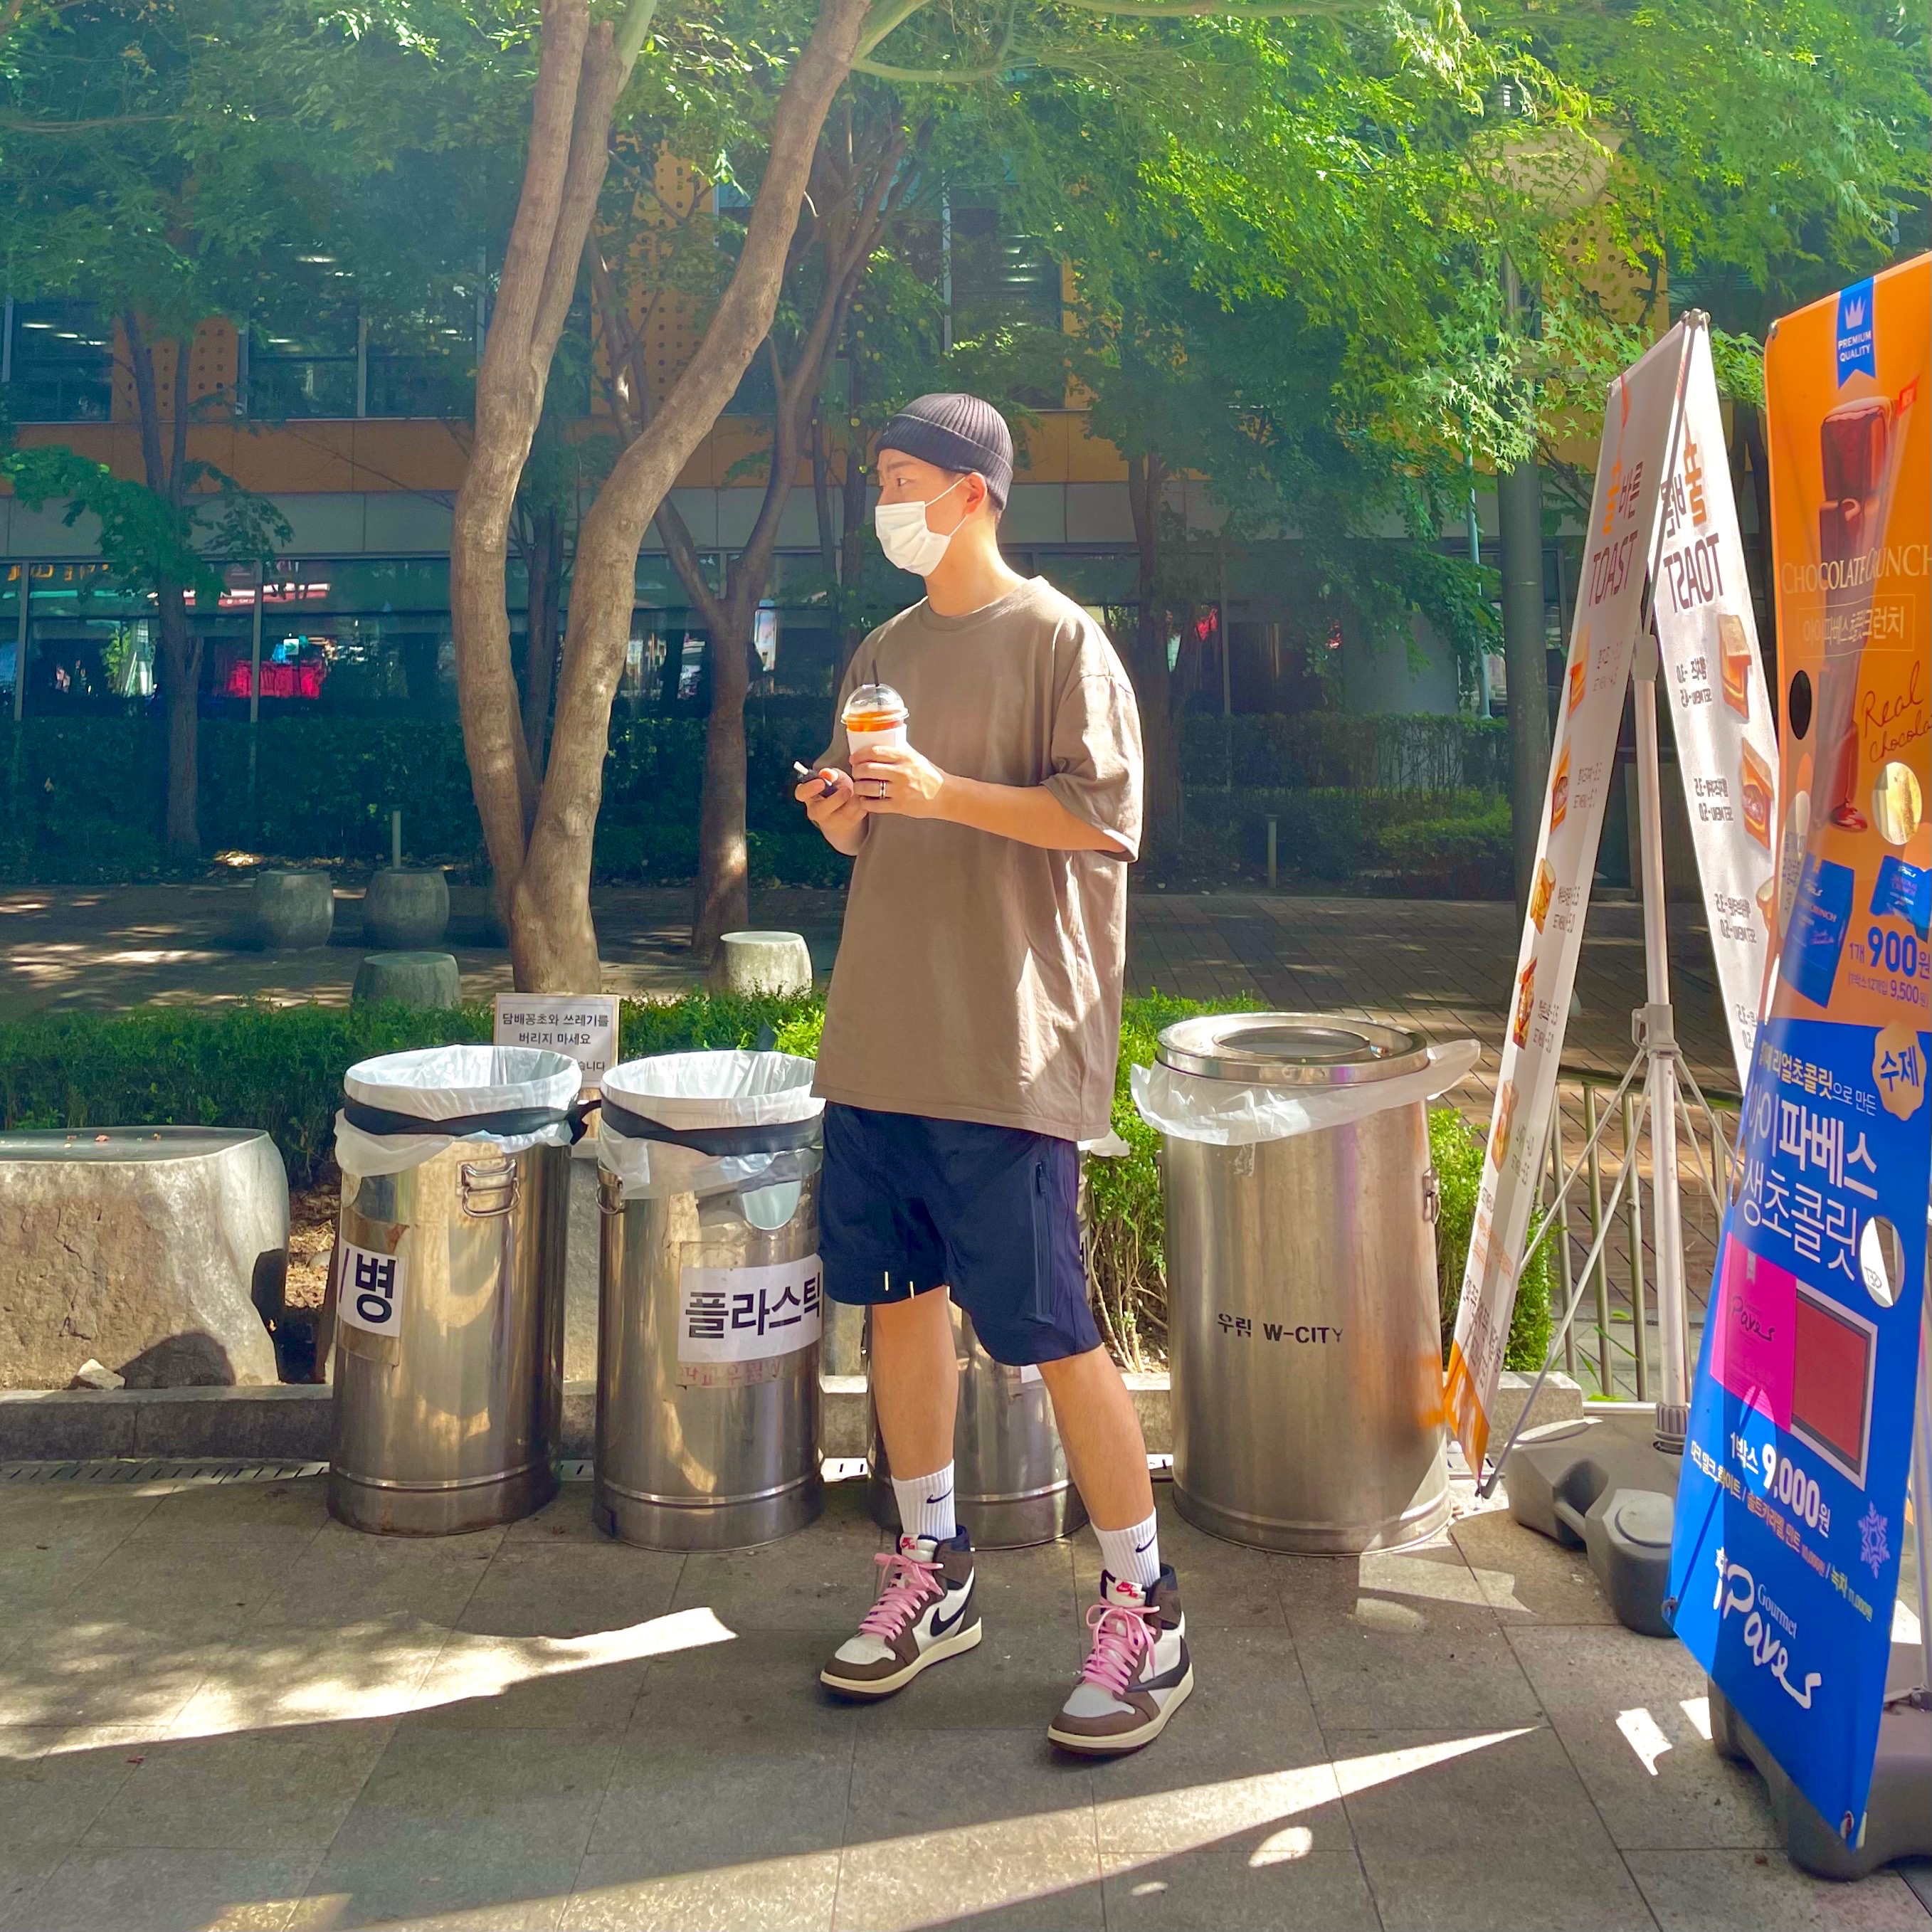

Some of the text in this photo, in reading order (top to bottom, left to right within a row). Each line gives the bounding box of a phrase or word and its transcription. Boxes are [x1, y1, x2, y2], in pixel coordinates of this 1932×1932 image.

[1838, 330, 1872, 350] PREMIUM
[1839, 344, 1871, 362] QUALITY
[1588, 529, 1638, 608] TOAST
[1782, 556, 1866, 594] CHOCOLATE
[1862, 660, 1924, 739] Real
[1849, 943, 1866, 963] 1개
[502, 1013, 609, 1027] 담배꽁초와 쓰레기를
[519, 1033, 591, 1045] 버리지 마세요
[1773, 1050, 1853, 1105] 리얼초콜릿으로
[1856, 1089, 1876, 1117] 만든
[1880, 1045, 1920, 1092] 수제
[1743, 1158, 1858, 1282] 생초콜릿
[355, 1252, 397, 1324] 병
[685, 1272, 821, 1339] 플라스틱
[1263, 1323, 1343, 1344] W-CITY
[1731, 1431, 1759, 1475] 1박스
[1758, 1583, 1798, 1640] Gourmet
